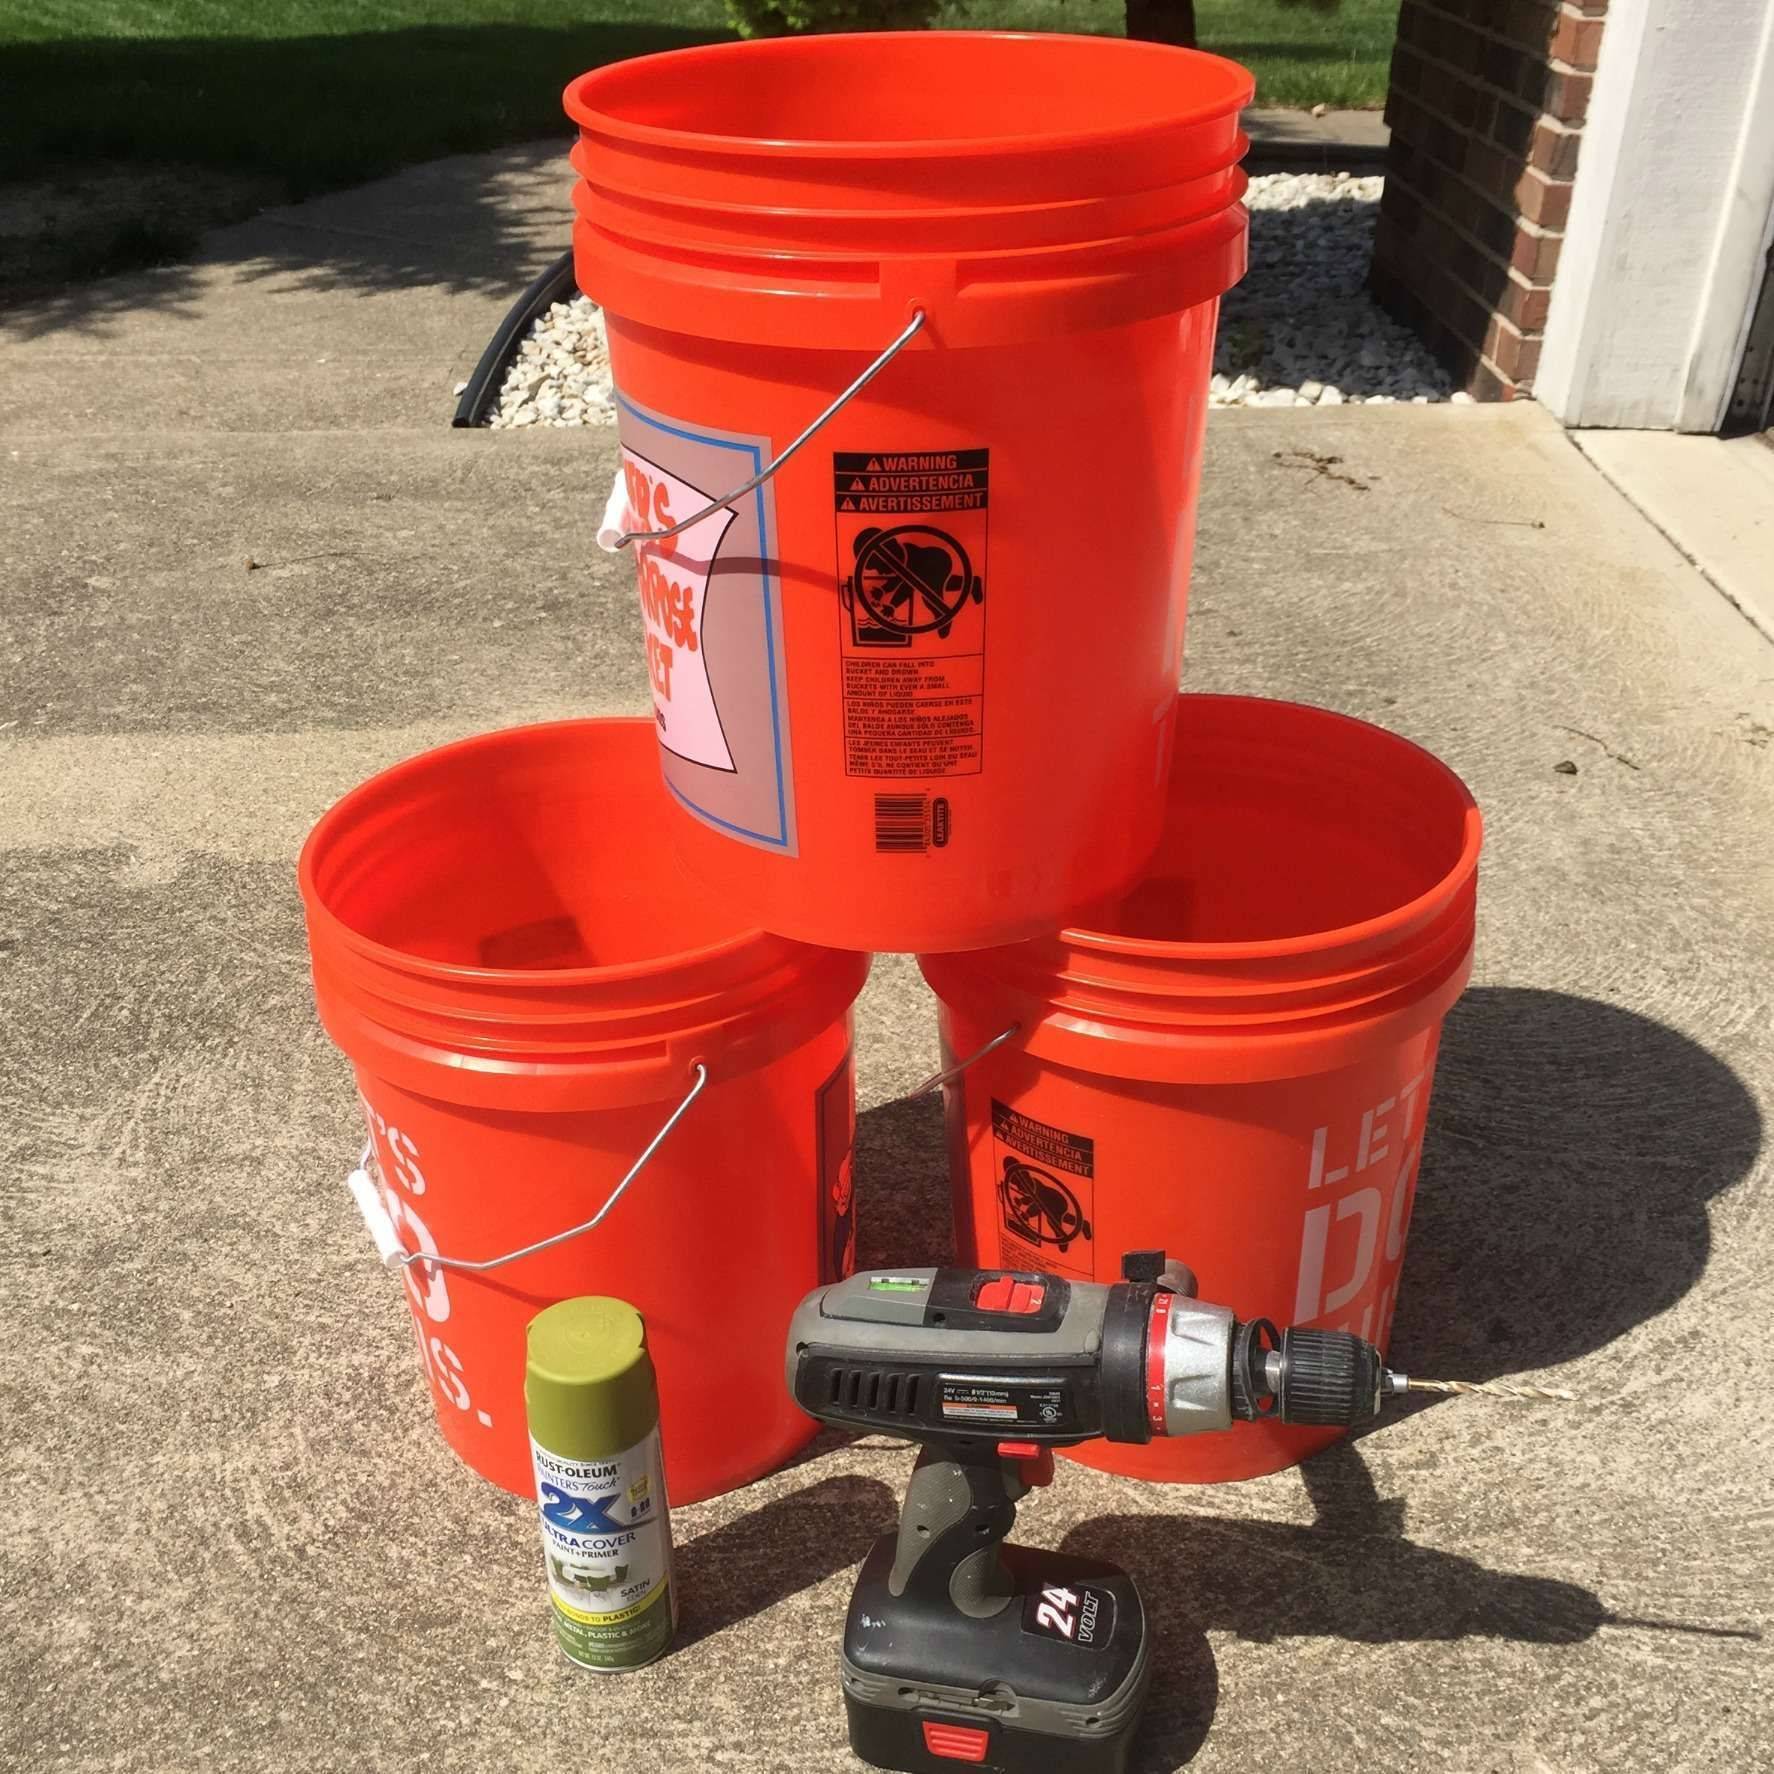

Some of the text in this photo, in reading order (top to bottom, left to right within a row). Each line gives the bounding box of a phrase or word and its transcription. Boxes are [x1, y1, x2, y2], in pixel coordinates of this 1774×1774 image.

[883, 455, 957, 471] WARNING
[869, 474, 974, 491] ADVERTENCIA
[860, 493, 983, 511] AVERTISSEMENT
[1012, 1126, 1082, 1161] ADVERTENCIA
[1019, 1117, 1069, 1144] WARNING
[1006, 1135, 1090, 1176] AVERTISSEMENT
[541, 1482, 625, 1534] 2X
[621, 1579, 650, 1597] SATIN
[1036, 1587, 1078, 1639] 24
[1078, 1591, 1099, 1642] VOLT
[588, 1631, 620, 1639] PLASTIC
